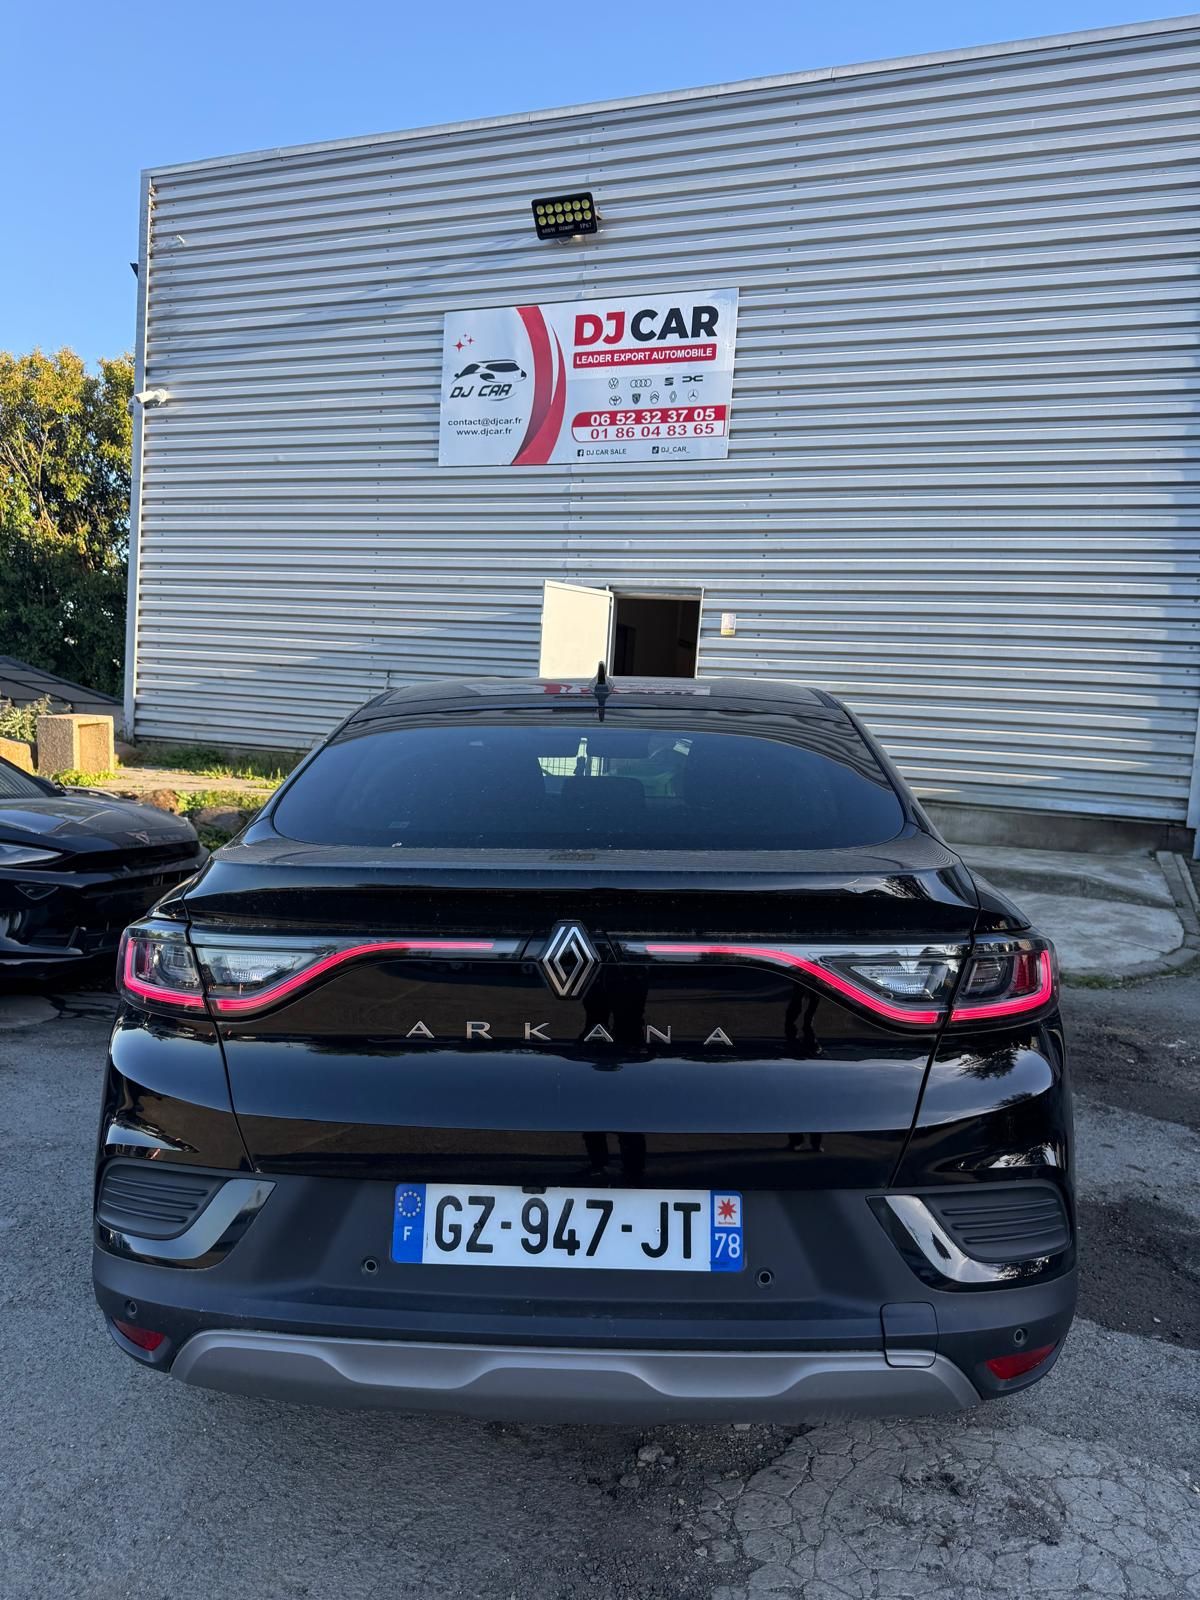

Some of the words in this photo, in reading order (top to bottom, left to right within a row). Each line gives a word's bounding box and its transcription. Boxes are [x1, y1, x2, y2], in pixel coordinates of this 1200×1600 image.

[574, 311, 625, 347] DJ
[630, 305, 719, 341] CAR
[576, 353, 613, 364] LEADER
[614, 350, 651, 363] EXPORT
[652, 347, 713, 361] AUTOMOBILE
[449, 386, 474, 398] DJ
[478, 384, 512, 397] CAR
[448, 417, 522, 426] contact@djcar.fr
[590, 413, 611, 426] 06
[615, 412, 636, 425] 52
[641, 411, 662, 424] 32
[667, 409, 688, 422] 37
[693, 408, 716, 421] 05
[456, 427, 513, 436] www.djcar.fr
[590, 427, 609, 440] 01
[615, 426, 635, 439] 86
[641, 425, 661, 438] 04
[667, 424, 688, 437] 83
[693, 422, 715, 435] 65
[595, 448, 609, 456] CAR
[609, 447, 627, 455] SALE
[406, 1020, 734, 1046] ARKANA
[403, 1226, 412, 1241] F
[434, 1195, 702, 1259] GZ-947-JT
[714, 1233, 740, 1258] 78
